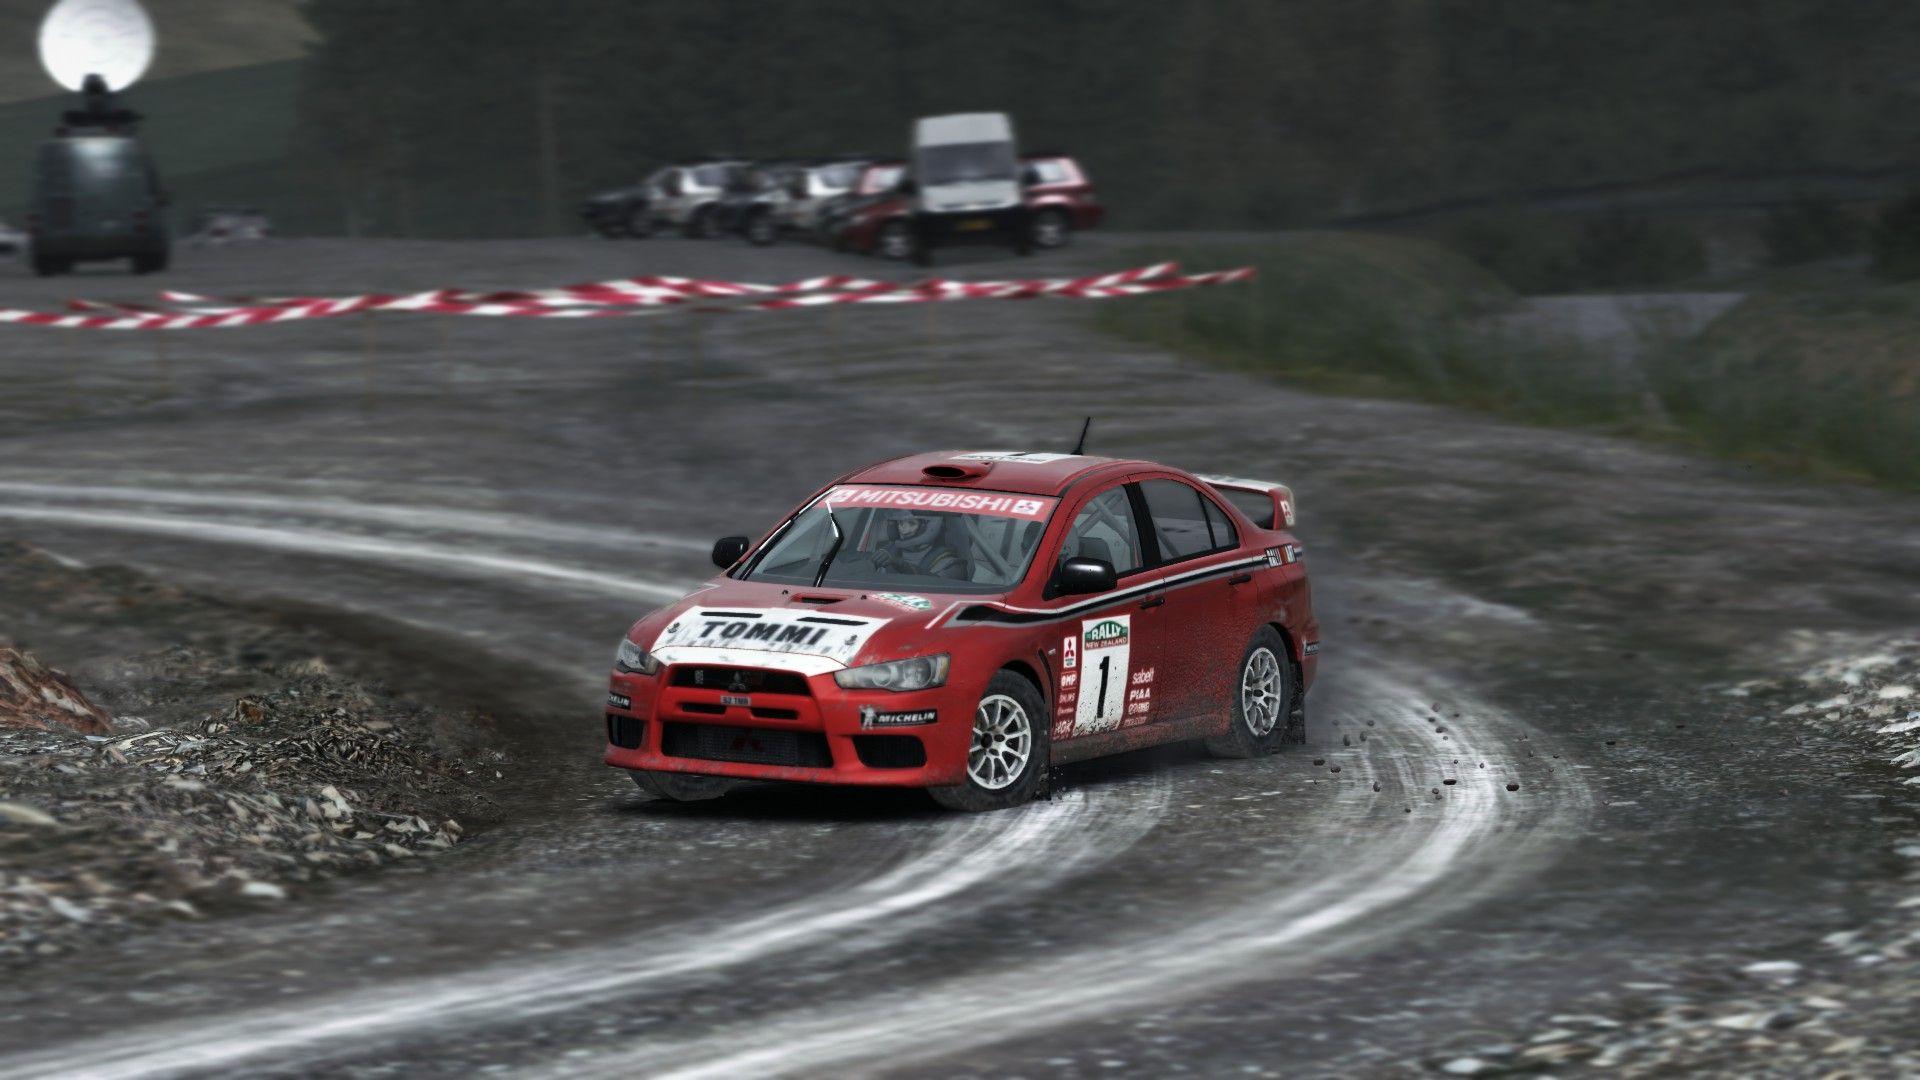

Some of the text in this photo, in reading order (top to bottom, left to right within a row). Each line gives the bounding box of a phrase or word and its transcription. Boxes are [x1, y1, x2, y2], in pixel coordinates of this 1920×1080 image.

[853, 490, 1012, 511] MITSUBISHI
[700, 620, 829, 646] TOMMI
[1091, 623, 1121, 640] RALLY
[1085, 637, 1127, 649] NEW ZEALAND
[1097, 655, 1110, 719] 1
[878, 711, 936, 723] MICHELIN
